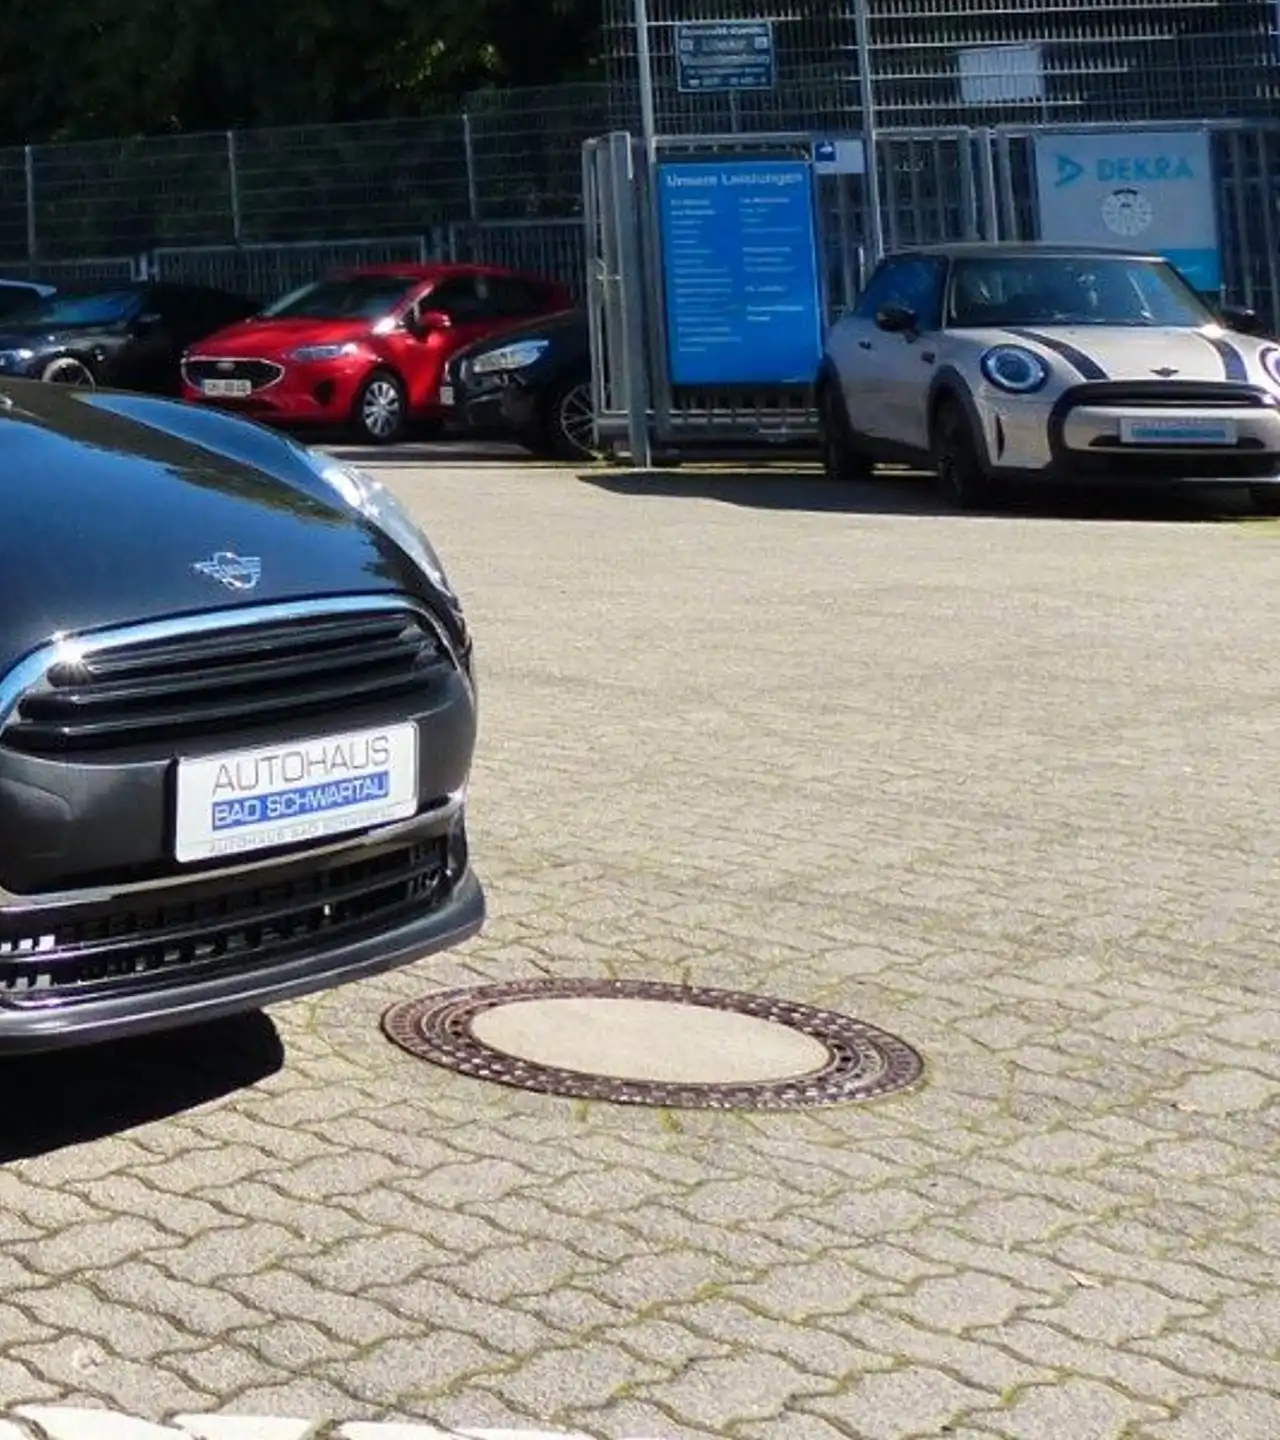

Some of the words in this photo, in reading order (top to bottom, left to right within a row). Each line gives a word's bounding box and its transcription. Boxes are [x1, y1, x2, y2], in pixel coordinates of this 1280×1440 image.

[1096, 157, 1194, 181] DEKRA
[212, 735, 389, 797] AUTOHAUS
[214, 799, 262, 827] BAD
[267, 777, 387, 818] SCHWARTAU
